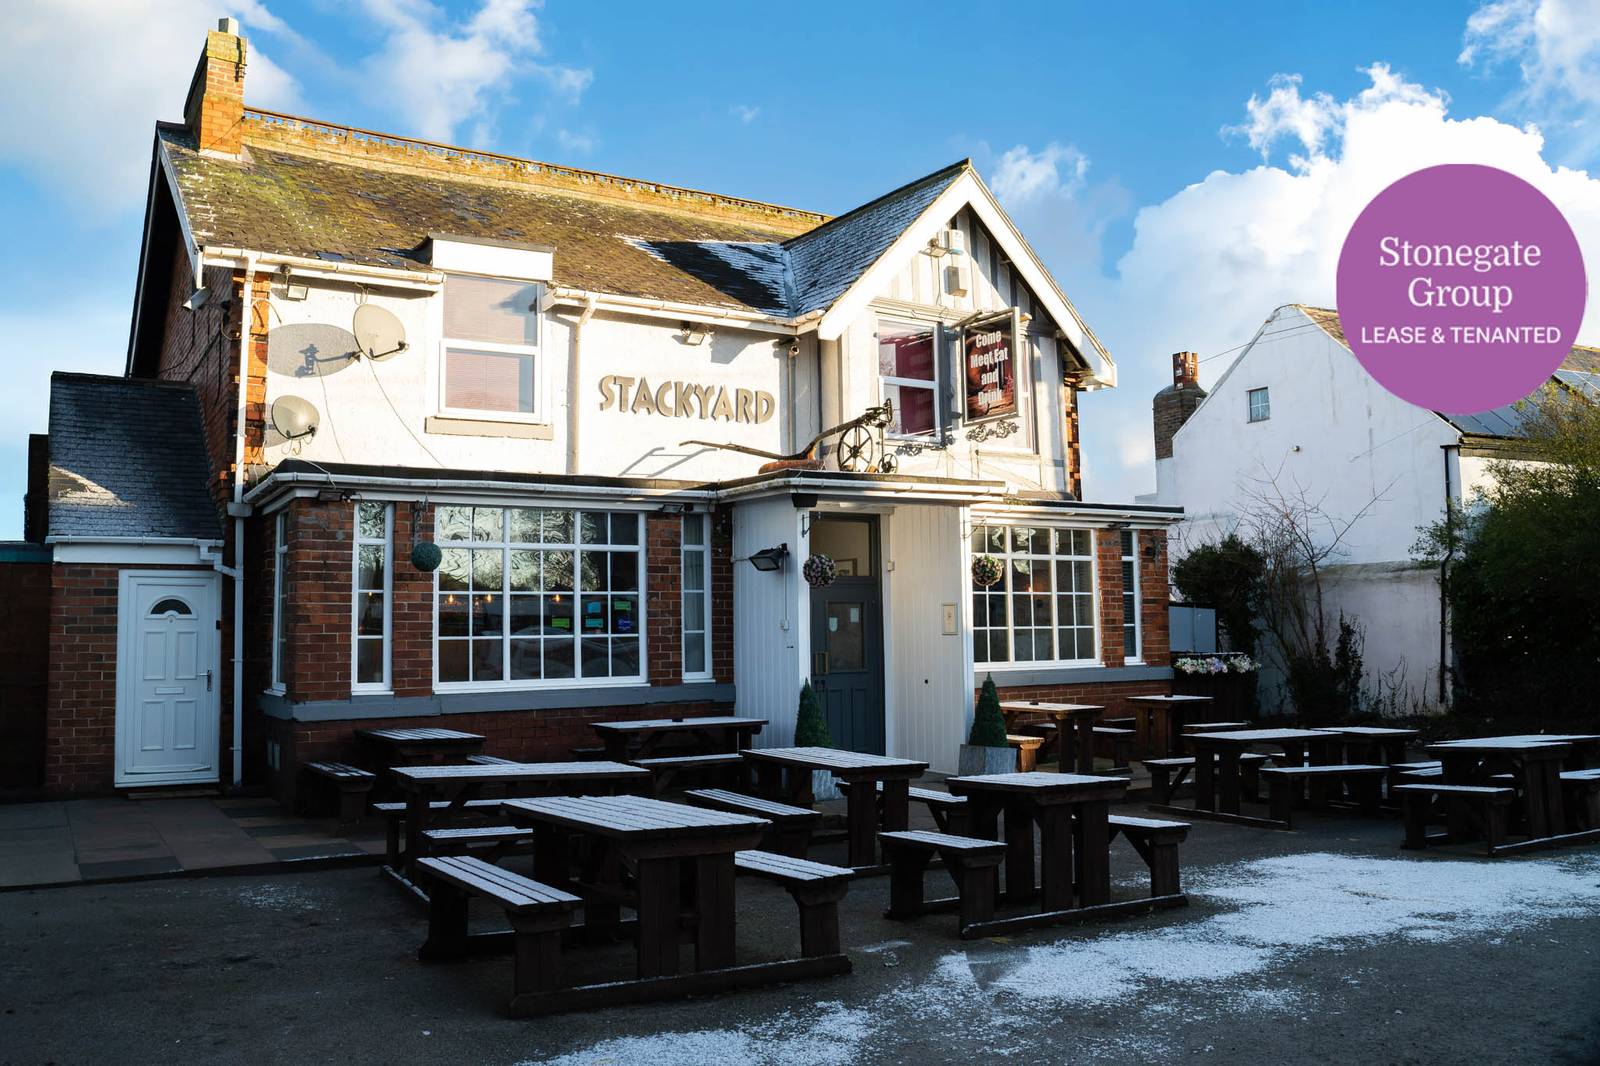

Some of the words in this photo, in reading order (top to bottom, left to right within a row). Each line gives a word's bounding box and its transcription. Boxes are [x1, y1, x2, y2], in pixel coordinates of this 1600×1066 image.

[976, 331, 1001, 347] Come
[994, 347, 1008, 363] Eat
[981, 370, 998, 385] and
[598, 374, 776, 424] STACKYARD
